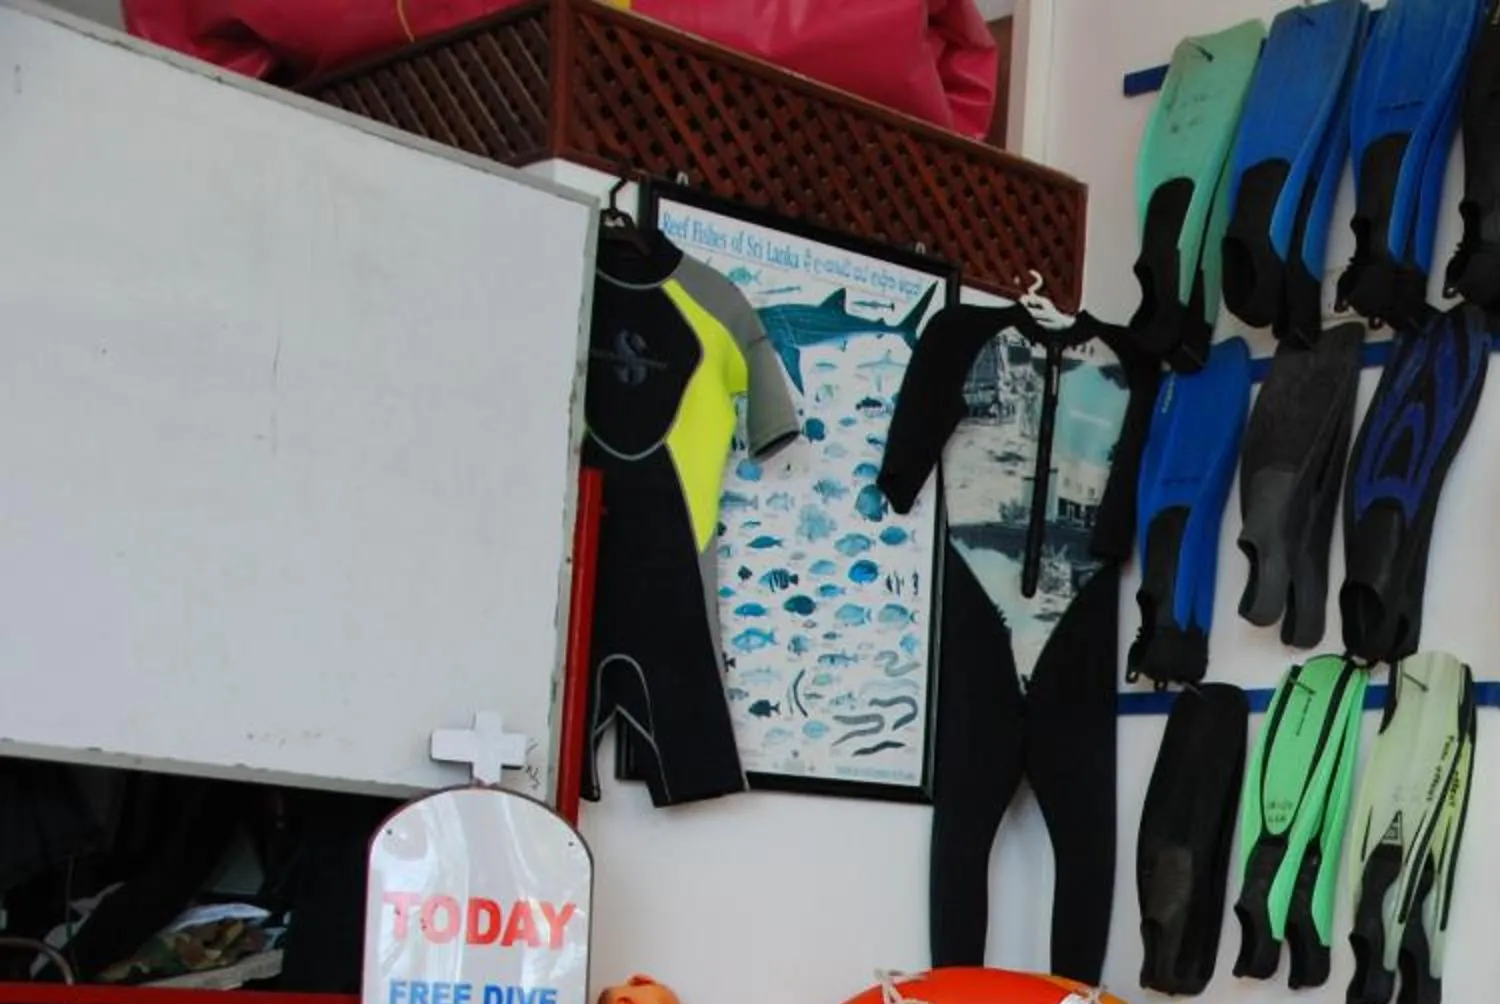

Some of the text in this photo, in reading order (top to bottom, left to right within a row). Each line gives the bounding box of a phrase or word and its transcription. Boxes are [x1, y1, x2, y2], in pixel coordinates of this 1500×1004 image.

[664, 211, 690, 239] Reef
[731, 230, 744, 254] of
[767, 241, 800, 269] Lanka
[383, 892, 576, 949] TODAY
